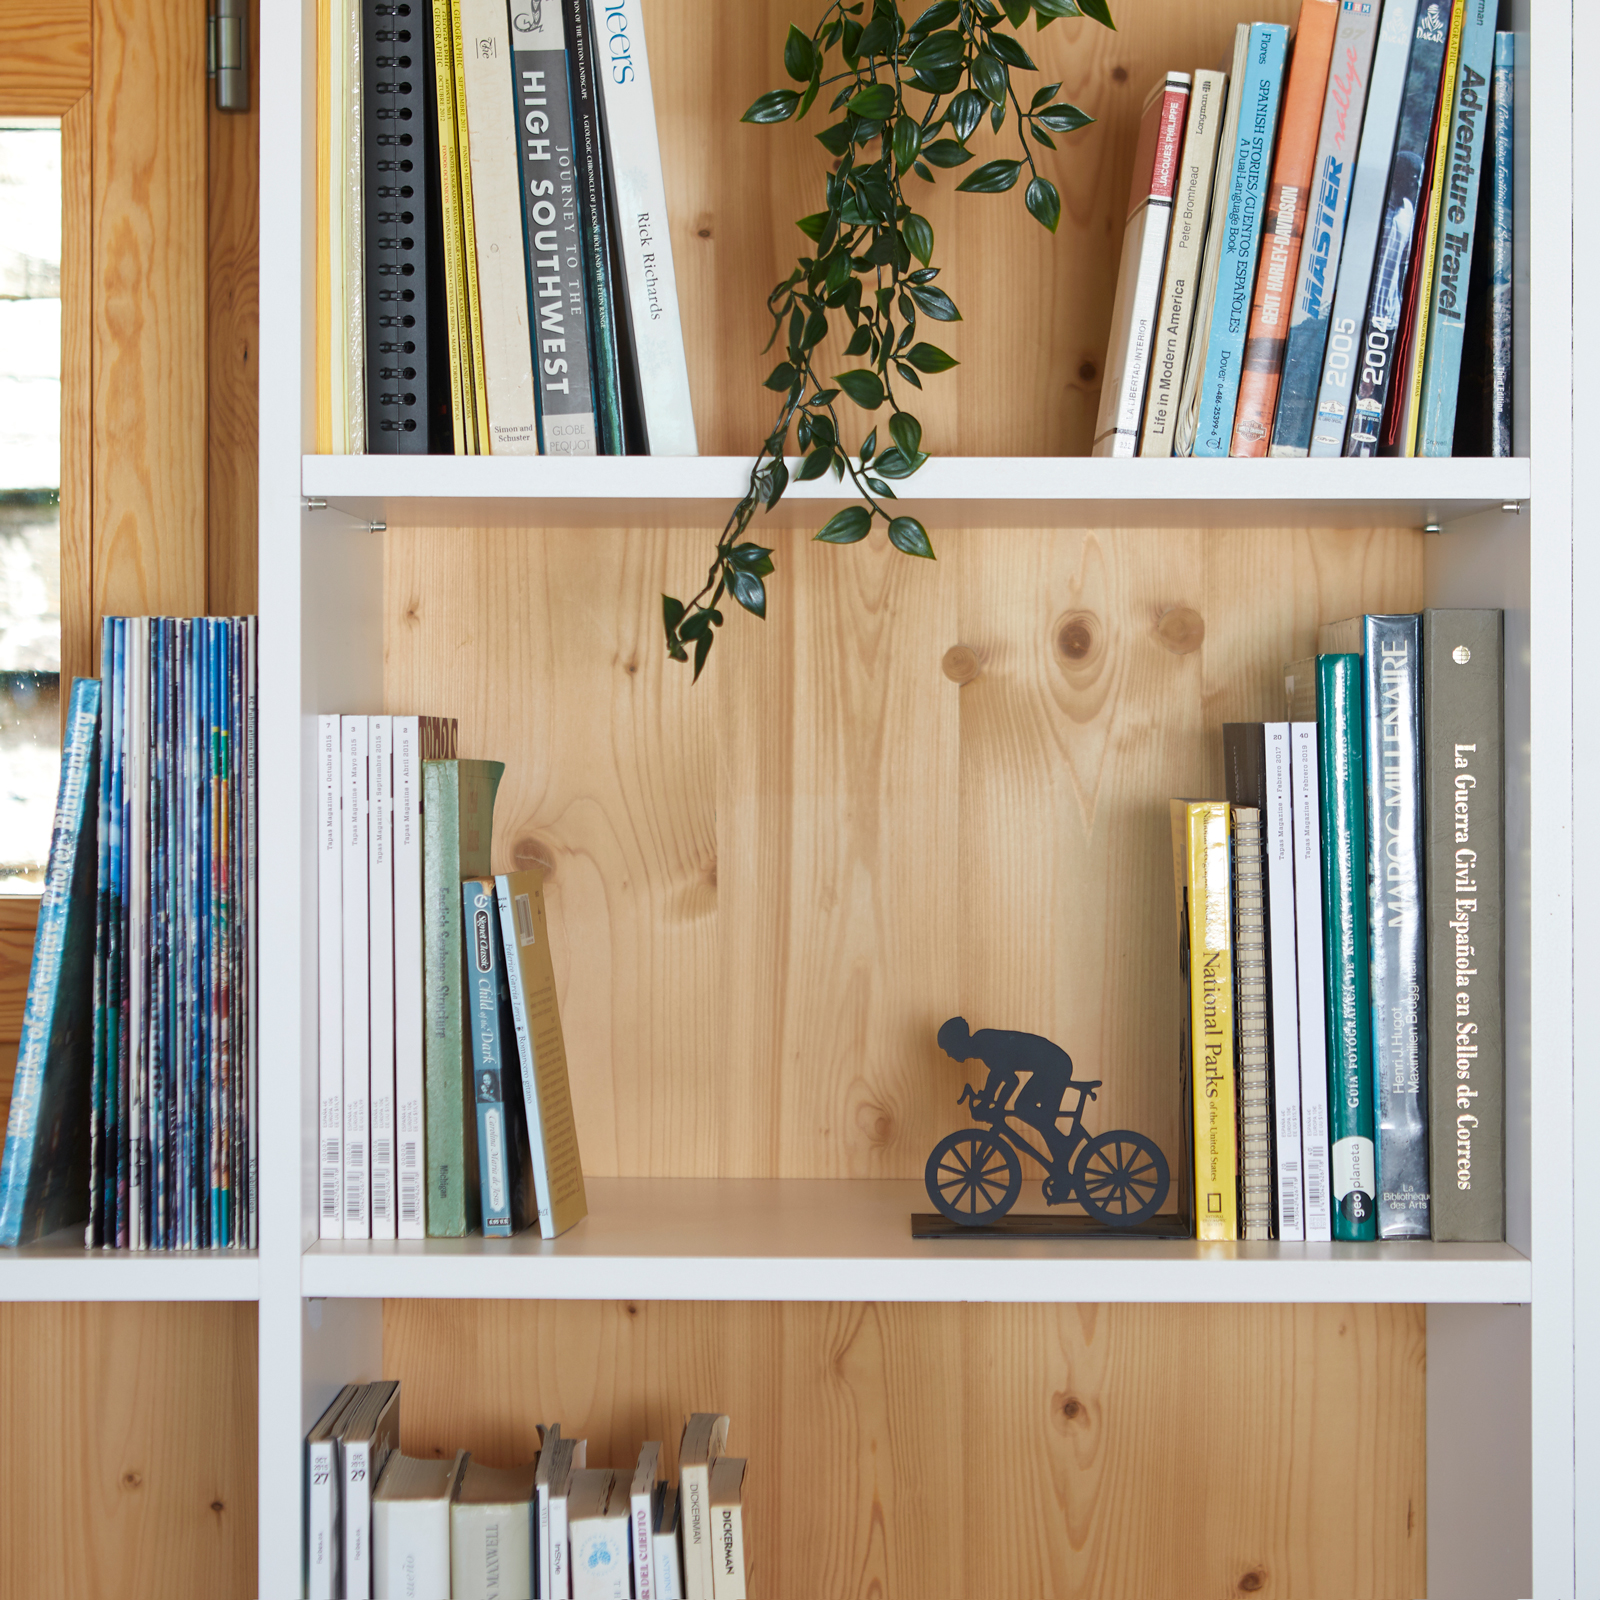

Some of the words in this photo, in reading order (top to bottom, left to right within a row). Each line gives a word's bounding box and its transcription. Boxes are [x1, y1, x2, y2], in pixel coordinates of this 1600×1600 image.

[575, 14, 581, 23] OF
[1340, 27, 1366, 40] 97
[1416, 26, 1444, 44] DAKAR
[434, 7, 443, 68] GEOGRAPHIC
[453, 9, 463, 69] GEOGRAPHIC
[480, 37, 493, 59] The
[1258, 32, 1272, 65] Flores
[1448, 7, 1461, 67] GEOGRAPHIC
[579, 62, 587, 100] LANDSCAPE
[1324, 45, 1363, 152] rallye
[522, 70, 552, 162] HIGH
[1164, 102, 1178, 143] PHILIPPE
[1195, 93, 1210, 135] Longman
[1254, 79, 1271, 134] SPANISH
[1498, 107, 1508, 134] Parks
[583, 120, 592, 154] GEOLOGIC
[1240, 138, 1250, 147] A
[1447, 64, 1487, 226] Adventure
[1498, 135, 1508, 164] Visitor
[586, 155, 595, 193] CHRONICLE
[1159, 144, 1172, 187] JACQUES
[555, 145, 575, 234] JOURNEY
[590, 194, 596, 203] OF
[1182, 166, 1199, 220] Bromhead
[1228, 149, 1249, 226] Dual-Language
[1237, 136, 1265, 258] STORIES/CUENTOS
[1498, 165, 1508, 202] Facilities
[590, 204, 598, 233] JACKSON
[637, 212, 654, 246] Rick
[1178, 221, 1191, 249] Peter
[1226, 227, 1239, 255] Book
[1266, 185, 1298, 293] HARLEY-DAVIDSON
[1300, 155, 1343, 320] MASTER
[566, 244, 578, 268] TO
[529, 178, 569, 396] SOUTHWEST
[642, 252, 664, 320] Richards
[1437, 230, 1470, 320] Travel
[568, 279, 582, 316] THE
[597, 283, 605, 305] TETON
[1166, 278, 1185, 336] America
[1228, 260, 1250, 334] ESPAÑOLES
[1261, 294, 1281, 325] GENT
[1134, 318, 1147, 362] INTERIOR
[1326, 317, 1356, 388] 2005
[1362, 314, 1392, 386] 2004
[1159, 338, 1177, 391] Modern
[1218, 349, 1231, 381] Dover
[1497, 366, 1505, 386] Third
[1157, 393, 1169, 406] in
[1211, 383, 1224, 436] 0-486-25399-6
[1497, 387, 1505, 413] Edition
[499, 434, 530, 442] Schuster
[520, 424, 533, 432] and
[552, 424, 586, 436] GLOBE
[1153, 409, 1167, 435] Life
[550, 439, 590, 453] PEQUOT
[248, 696, 254, 705] KC
[247, 753, 255, 779] Catalog
[1453, 743, 1476, 769] La
[1303, 801, 1311, 837] Magazine
[1453, 774, 1477, 844] Guerra
[1304, 838, 1312, 859] Tapas
[1385, 812, 1407, 928] MAROC
[1454, 848, 1477, 893] Civil
[477, 915, 488, 940] Signet
[1449, 898, 1478, 987] Española
[25, 919, 60, 1018] adventure
[480, 939, 489, 969] Classic
[478, 978, 494, 1011] Child
[506, 943, 516, 973] Federico
[513, 1001, 523, 1022] Lorca
[1202, 951, 1223, 1037] National
[436, 985, 449, 1039] Structure
[1456, 992, 1471, 1017] en
[21, 1017, 45, 1041] of
[1391, 1007, 1405, 1046] Hugot
[481, 1028, 497, 1064] Dark
[519, 1035, 531, 1079] Romancero
[1392, 1048, 1404, 1058] J.
[1406, 1027, 1419, 1094] Maximilien
[1456, 1022, 1478, 1080] Sellos
[13, 1041, 41, 1097] miles
[1204, 1042, 1225, 1098] Parks
[1392, 1060, 1404, 1094] Henri
[522, 1080, 533, 1105] gitano
[1208, 1101, 1217, 1110] of
[1456, 1084, 1478, 1109] de
[5, 1097, 32, 1140] 1000
[1209, 1110, 1218, 1125] the
[1209, 1126, 1219, 1155] United
[1457, 1114, 1479, 1190] Correos
[249, 1158, 255, 1168] KC
[1210, 1156, 1219, 1182] States
[1350, 1144, 1364, 1189] planeta
[438, 1164, 449, 1199] Michigan
[1402, 1184, 1414, 1193] La
[1352, 1193, 1366, 1218] geo
[1390, 1201, 1406, 1209] des
[1408, 1201, 1427, 1209] Arts
[352, 1453, 363, 1461] DIC
[313, 1473, 329, 1485] 27
[351, 1469, 366, 1482] 29
[690, 1484, 701, 1545] DICKERMAN
[486, 1524, 499, 1588] MAXWELL
[723, 1510, 734, 1575] DICKERMAN
[640, 1564, 650, 1587] DEL
